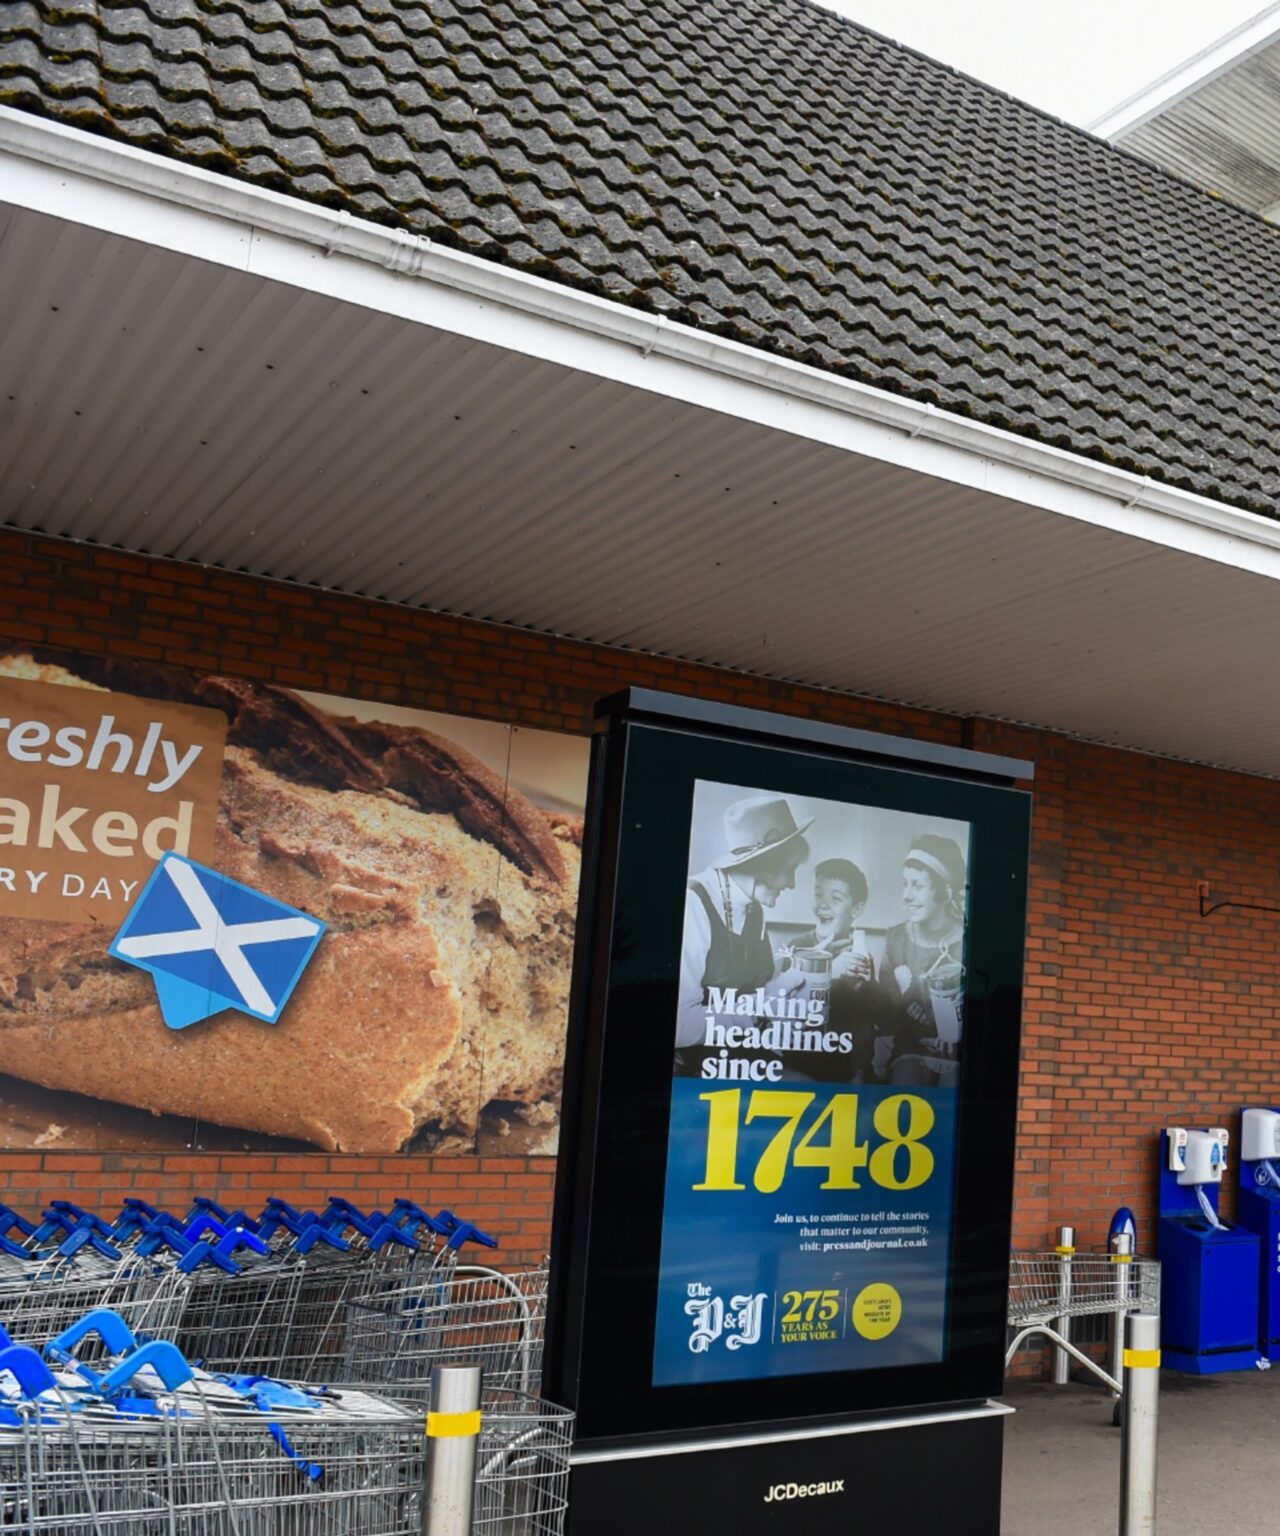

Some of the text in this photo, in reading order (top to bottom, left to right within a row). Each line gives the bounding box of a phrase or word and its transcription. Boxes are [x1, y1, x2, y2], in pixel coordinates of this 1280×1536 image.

[62, 873, 139, 902] DAY
[705, 986, 825, 1027] Making
[703, 1016, 853, 1053] headlines
[701, 1049, 783, 1082] since
[692, 1088, 935, 1193] 1748
[773, 1210, 929, 1224] Join us, to continue to tell the stories
[800, 1224, 929, 1236] that matter to our community,
[800, 1237, 928, 1252] visit: pressandjournal.co.uk
[687, 1283, 712, 1297] The
[782, 1290, 840, 1323] 275
[780, 1330, 838, 1343] YOUR VOICE
[781, 1320, 828, 1332] YEARS AS
[763, 1479, 844, 1502] JCDecaux
